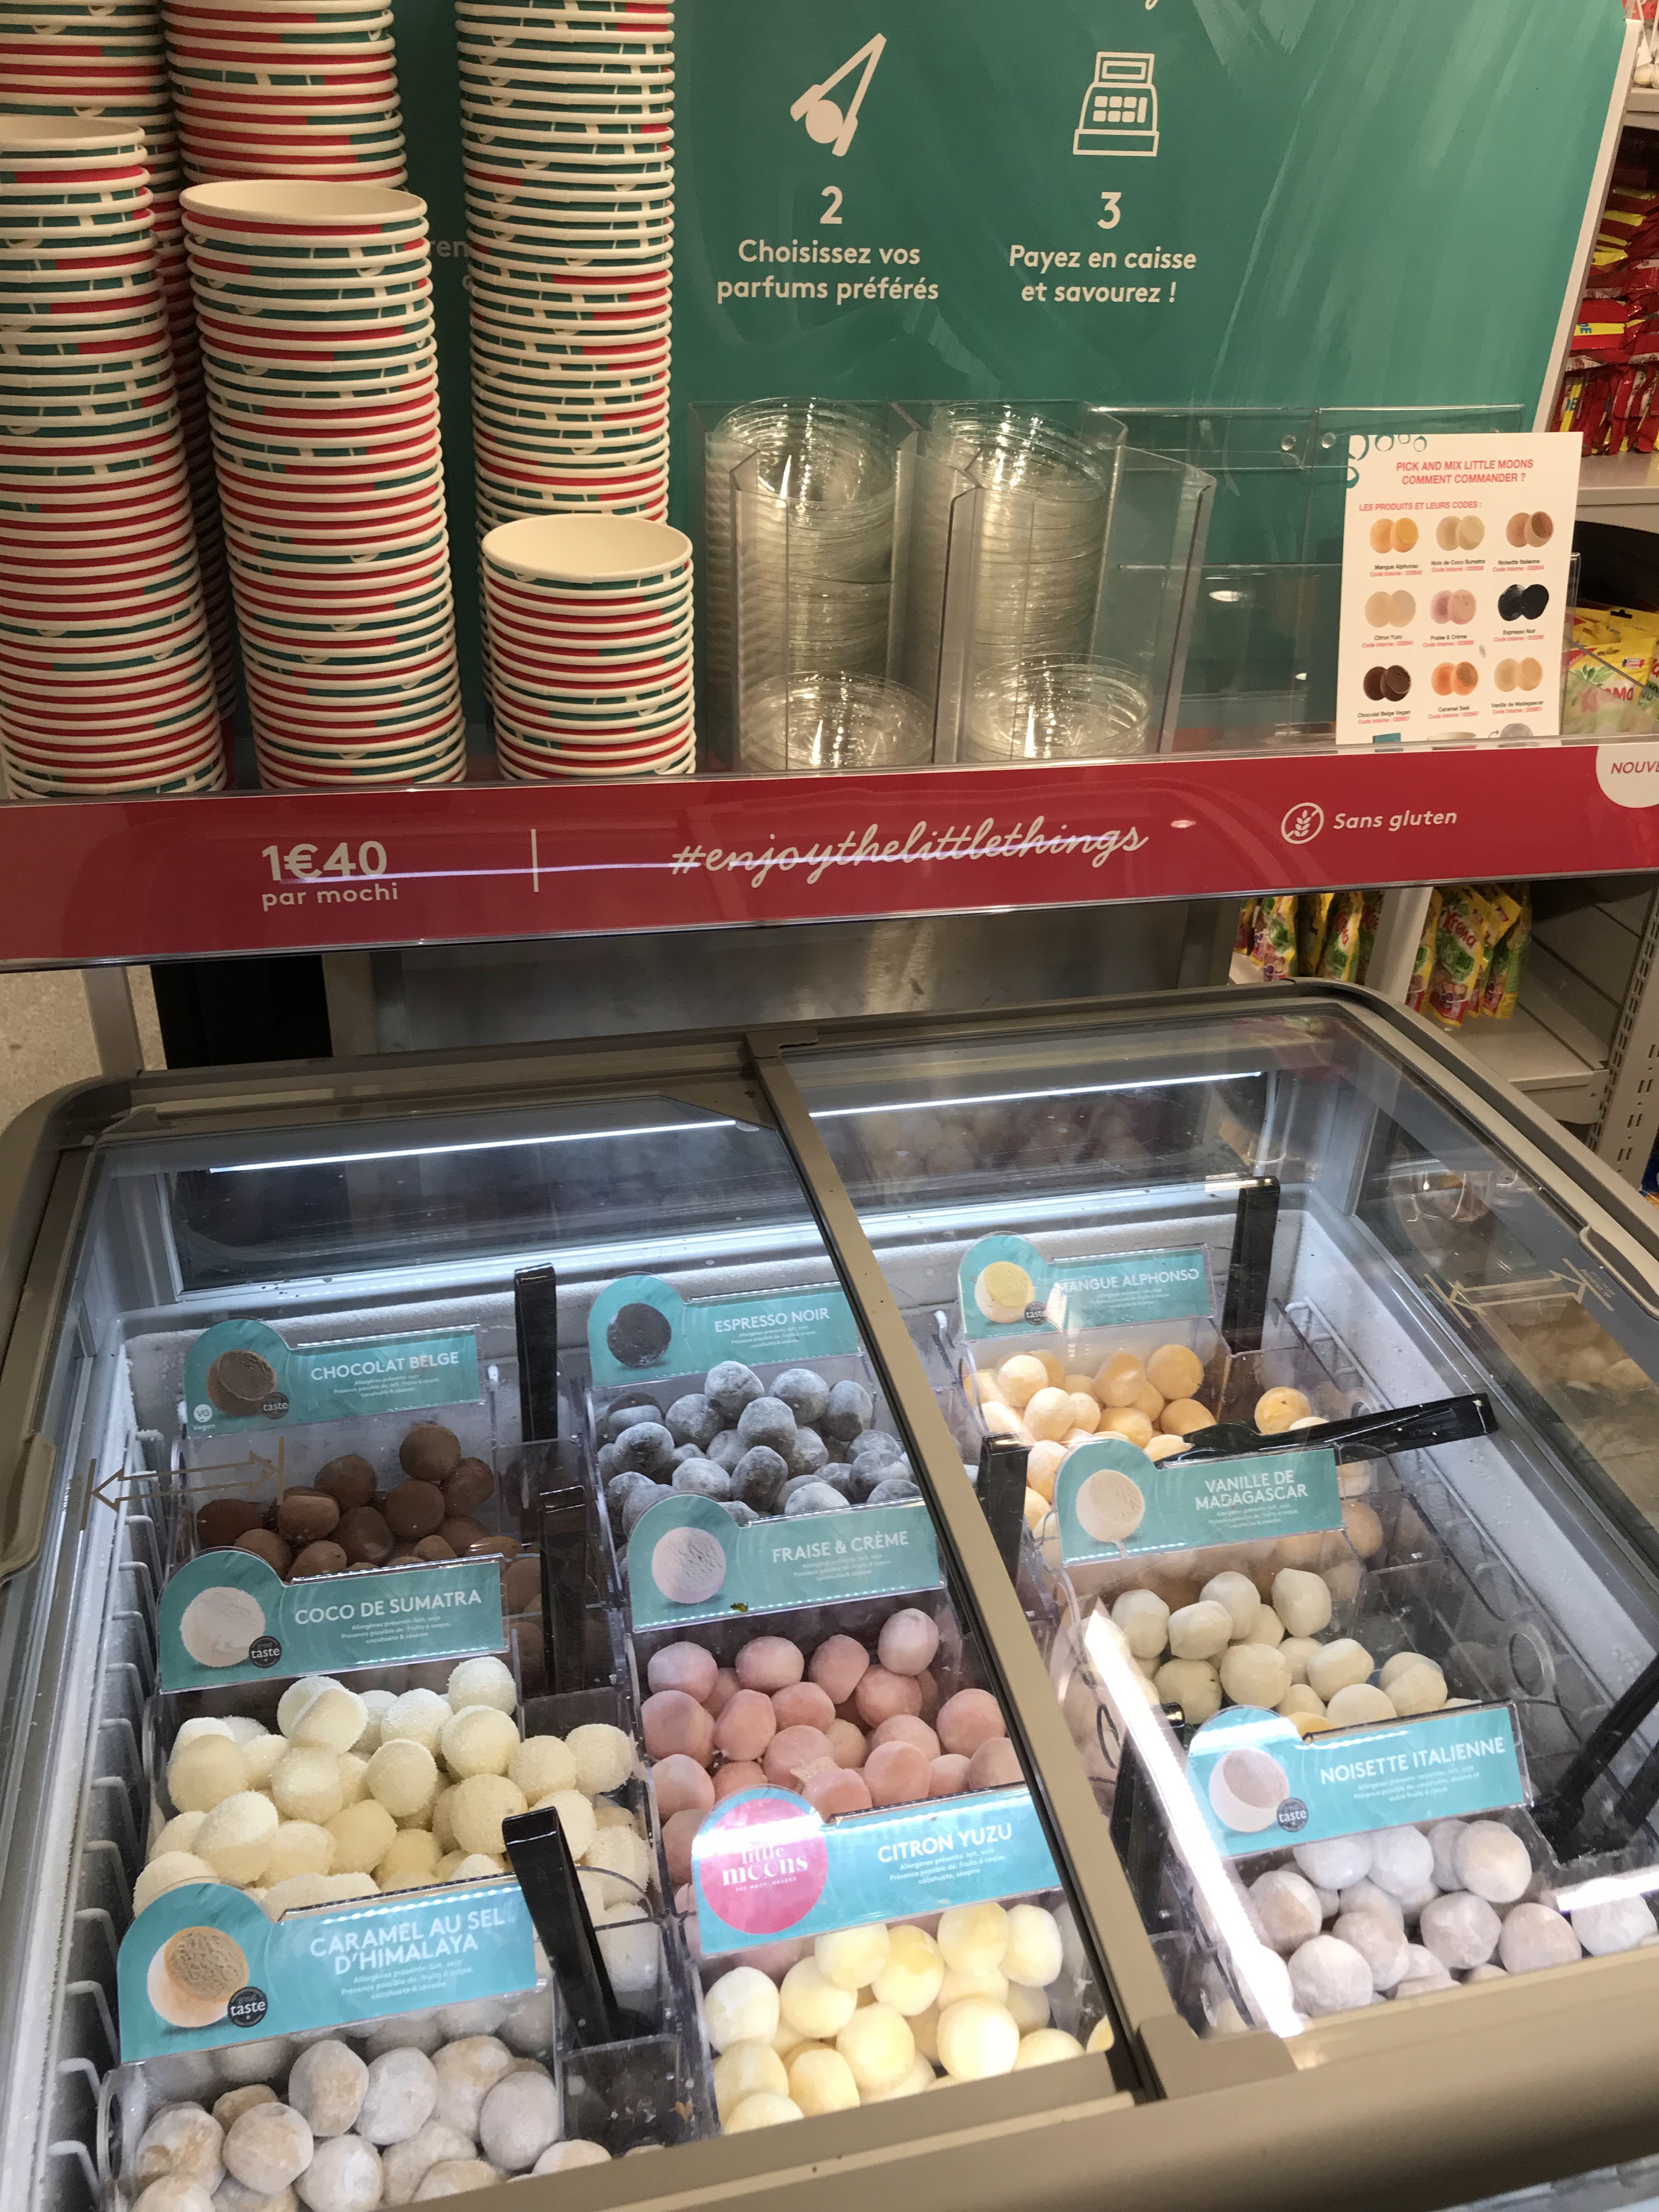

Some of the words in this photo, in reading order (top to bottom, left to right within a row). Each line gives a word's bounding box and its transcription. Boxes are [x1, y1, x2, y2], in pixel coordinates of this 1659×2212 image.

[820, 185, 843, 224] 2
[1097, 190, 1122, 230] 3
[738, 239, 871, 264] Choisissez
[879, 246, 921, 265] vos
[1009, 244, 1080, 271] Payez
[1088, 251, 1117, 269] en
[1125, 248, 1197, 271] caisse
[716, 275, 828, 305] parfums
[837, 275, 939, 306] préférés
[1022, 283, 1046, 303] et
[1053, 285, 1161, 304] savourez
[1169, 281, 1177, 303] !
[1396, 462, 1420, 471] PICK
[1421, 461, 1442, 471] AND
[1444, 461, 1463, 470] MIX
[1464, 460, 1496, 470] LITTLE
[1498, 459, 1534, 469] MOONS
[1402, 475, 1452, 484] COMMENT
[1454, 473, 1518, 483] COMMANDER
[1521, 473, 1526, 482] ?
[1375, 503, 1413, 511] PRODUITS
[1426, 501, 1451, 510] LEURS
[1333, 813, 1383, 830] Sans
[1389, 810, 1457, 832] gluten
[262, 841, 388, 881] 1€40
[671, 815, 1149, 889] #enjoythelittlethings
[262, 888, 304, 911] par
[317, 882, 399, 904] mochi
[1122, 1268, 1199, 1287] ALPHONSO
[715, 1313, 788, 1333] ESPRESSO
[791, 1307, 831, 1323] NOIR
[1025, 1310, 1048, 1318] taste
[311, 1358, 404, 1381] CHOCOLAT
[409, 1351, 459, 1369] BELGE
[263, 1402, 289, 1412] taste
[1204, 1473, 1269, 1494] VANILLE
[1274, 1470, 1295, 1485] DE
[1195, 1484, 1309, 1511] MADAGASCAR
[772, 1543, 830, 1564] FRAISE
[834, 1539, 848, 1554] &
[851, 1531, 910, 1552] CRÈME
[295, 1606, 356, 1625] COCO
[361, 1601, 385, 1618] DE
[389, 1589, 482, 1614] SUMATRA
[250, 1646, 281, 1660] taste
[1321, 1754, 1409, 1786] NOISETTE
[1413, 1736, 1506, 1769] ITALIENNE
[1279, 1810, 1307, 1823] taste
[742, 1844, 785, 1864] little
[877, 1836, 955, 1864] CITRON
[957, 1822, 1013, 1847] YUZU
[723, 1856, 809, 1886] moons
[309, 1921, 425, 1959] CARAMEL
[429, 1917, 463, 1939] AU
[467, 1906, 506, 1931] SEL
[335, 1933, 479, 1976] D'HIMALAYA
[230, 2001, 266, 2017] taste
